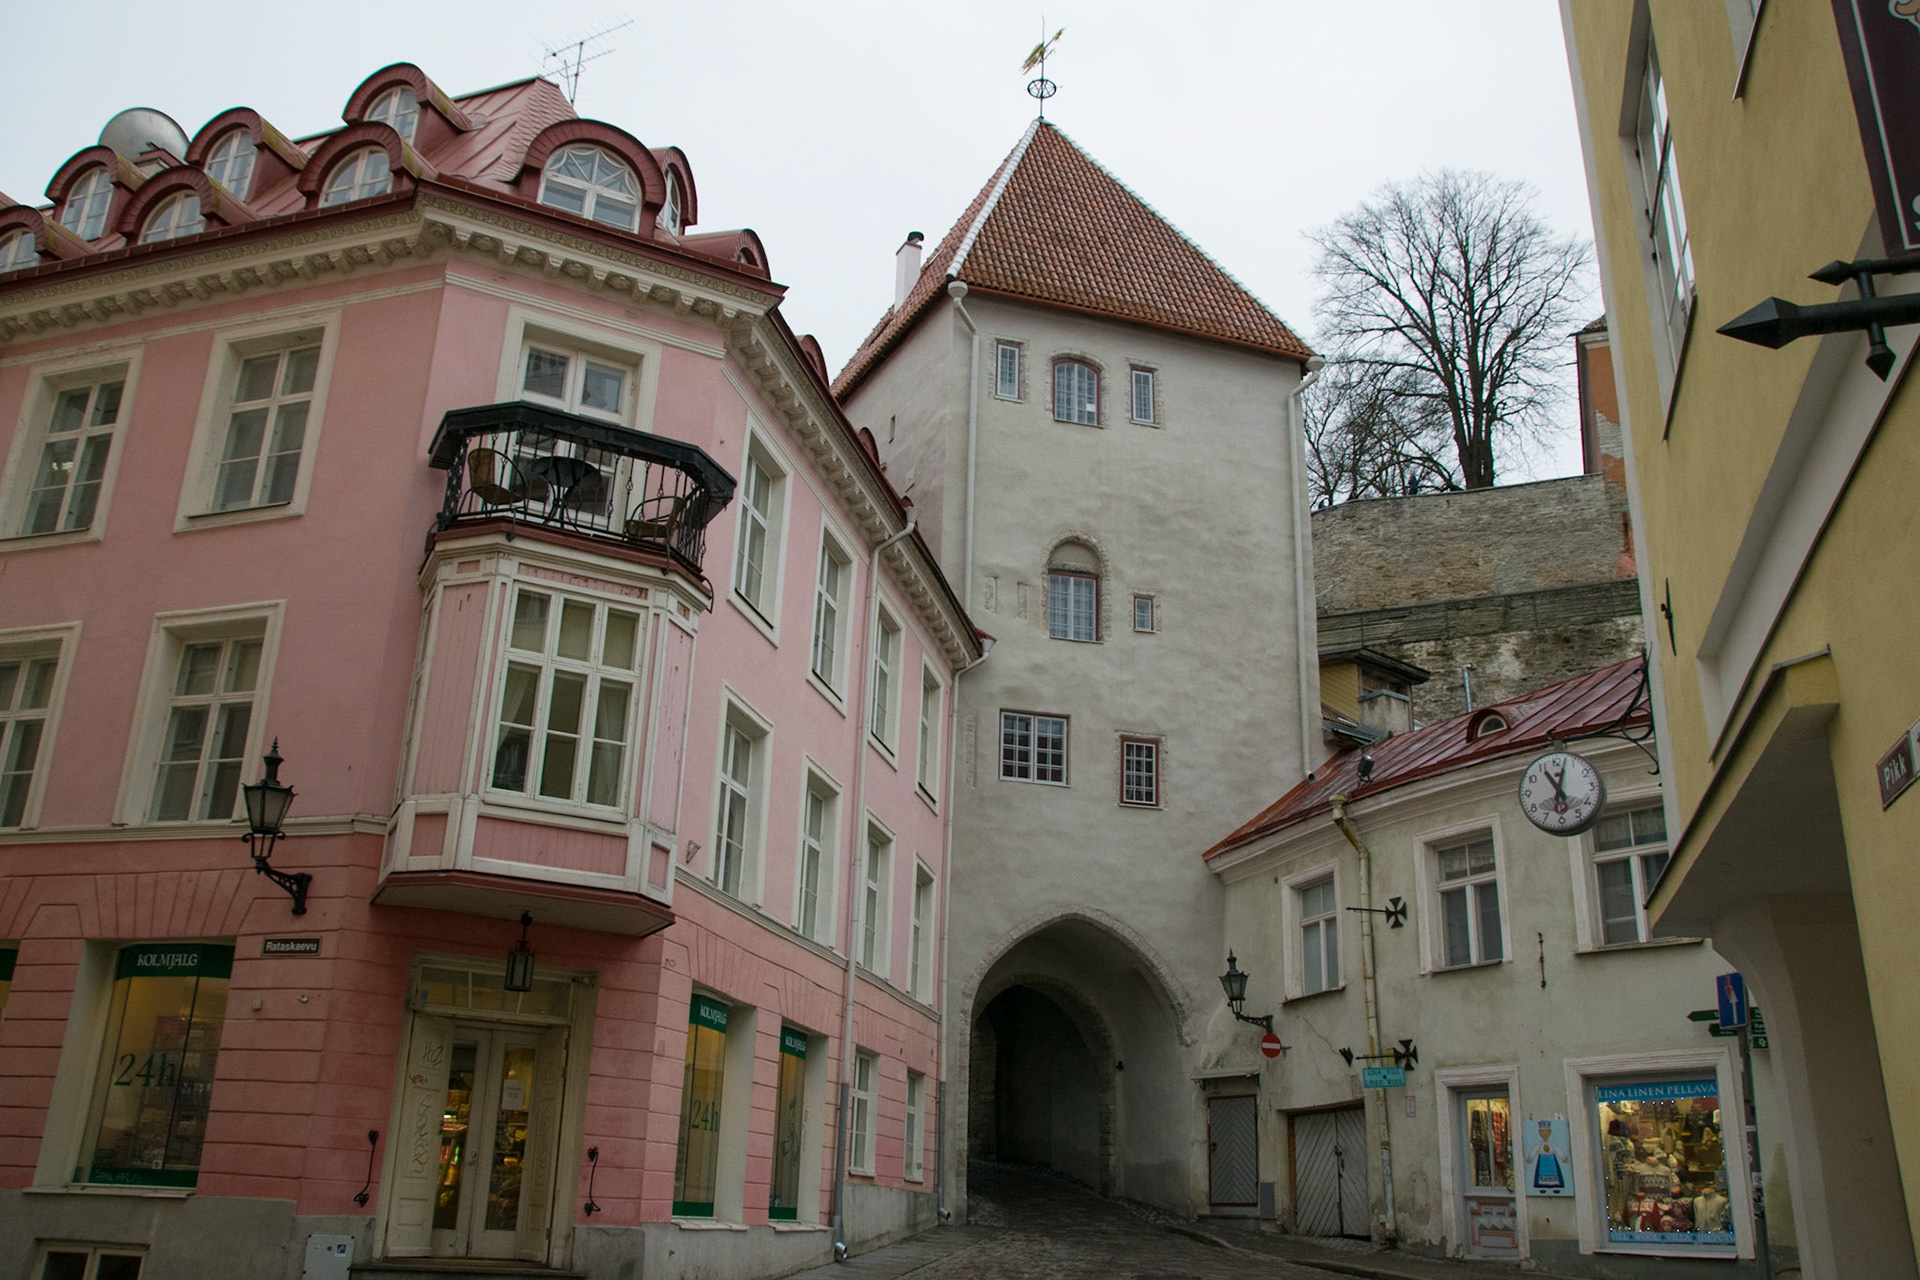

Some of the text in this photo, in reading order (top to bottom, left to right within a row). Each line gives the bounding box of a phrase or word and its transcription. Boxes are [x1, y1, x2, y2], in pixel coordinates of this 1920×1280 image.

[1552, 757, 1561, 767] 12
[1581, 768, 1589, 778] 2
[1883, 753, 1907, 790] Pikk
[1529, 774, 1537, 784] 10
[1588, 782, 1595, 791] 3
[1524, 789, 1532, 799] 9
[1584, 797, 1591, 806] 4
[1530, 803, 1537, 813] 8
[1575, 808, 1582, 818] 5
[1542, 812, 1549, 822] 7
[1558, 815, 1566, 824] 6
[265, 941, 318, 952] Rataskaevu
[113, 1052, 175, 1087] 24h
[1598, 1084, 1718, 1099] LINA LINEN PELLAVA
[690, 1099, 719, 1133] 24h
